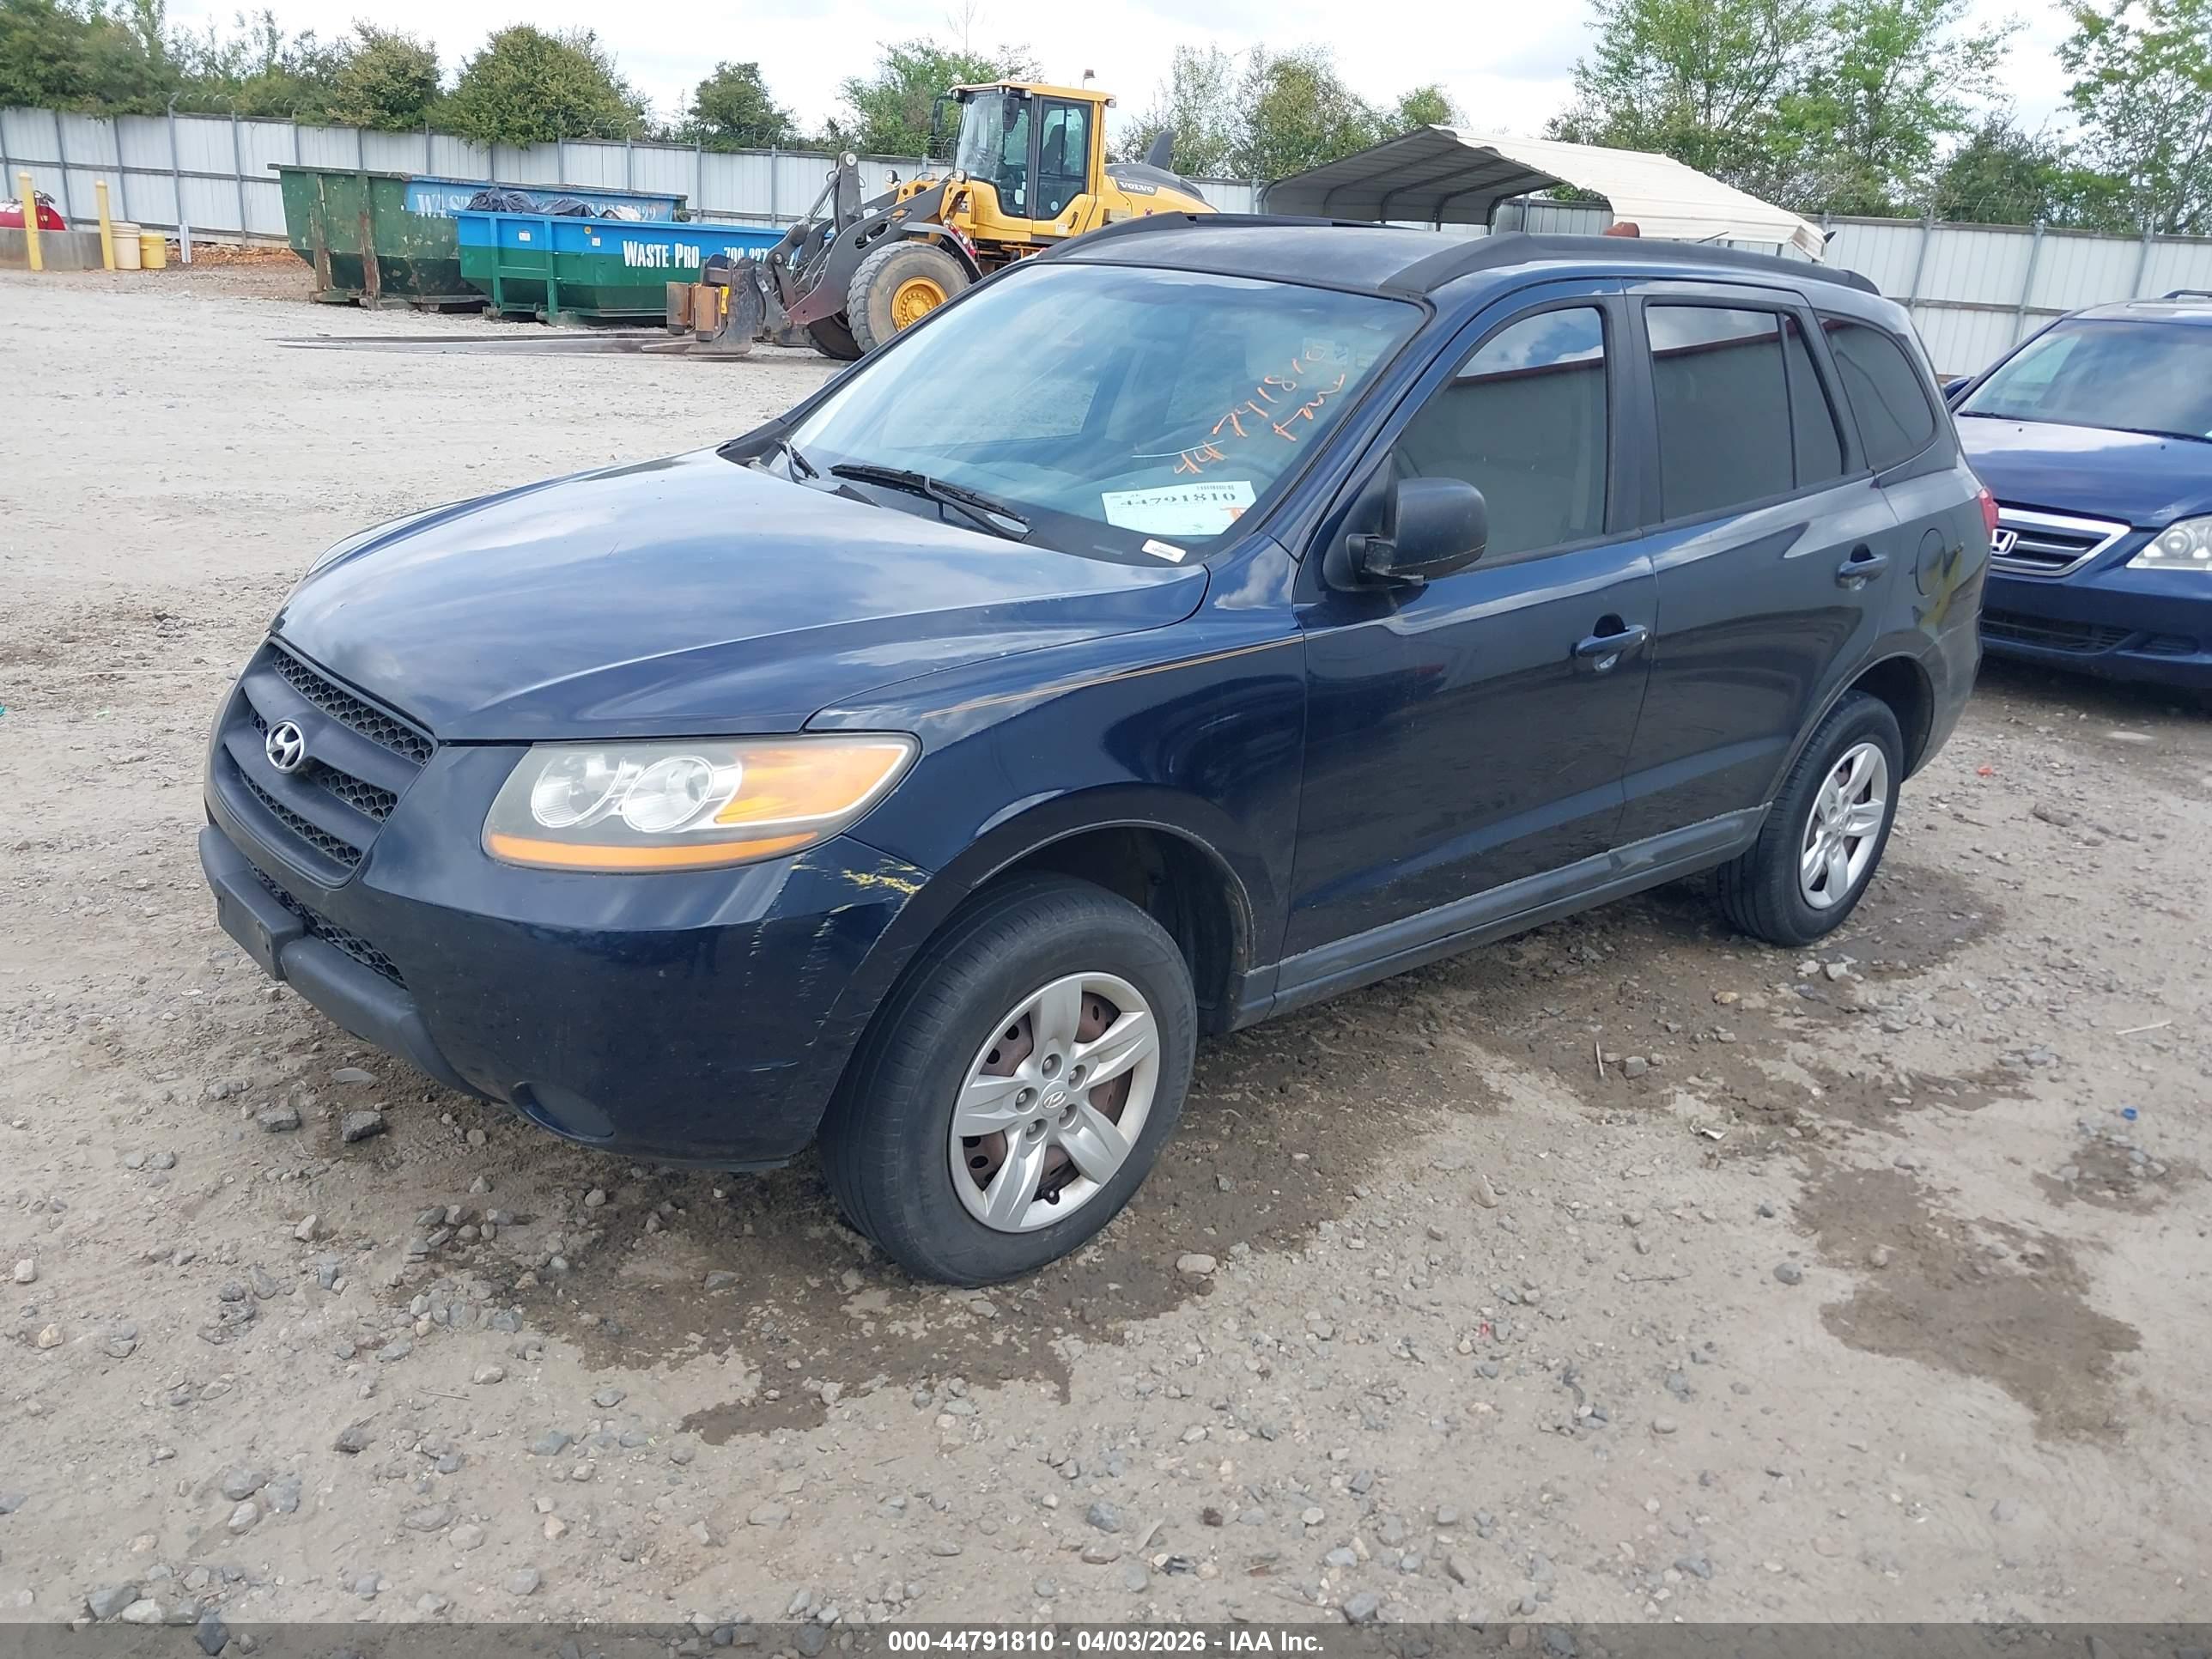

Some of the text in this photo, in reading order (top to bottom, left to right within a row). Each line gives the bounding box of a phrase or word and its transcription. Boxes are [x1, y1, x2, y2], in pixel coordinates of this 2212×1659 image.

[1119, 181, 1155, 193] VOLVO
[623, 240, 669, 268] WASTE
[674, 242, 700, 269] PRO
[1120, 492, 1237, 507] 44791810
